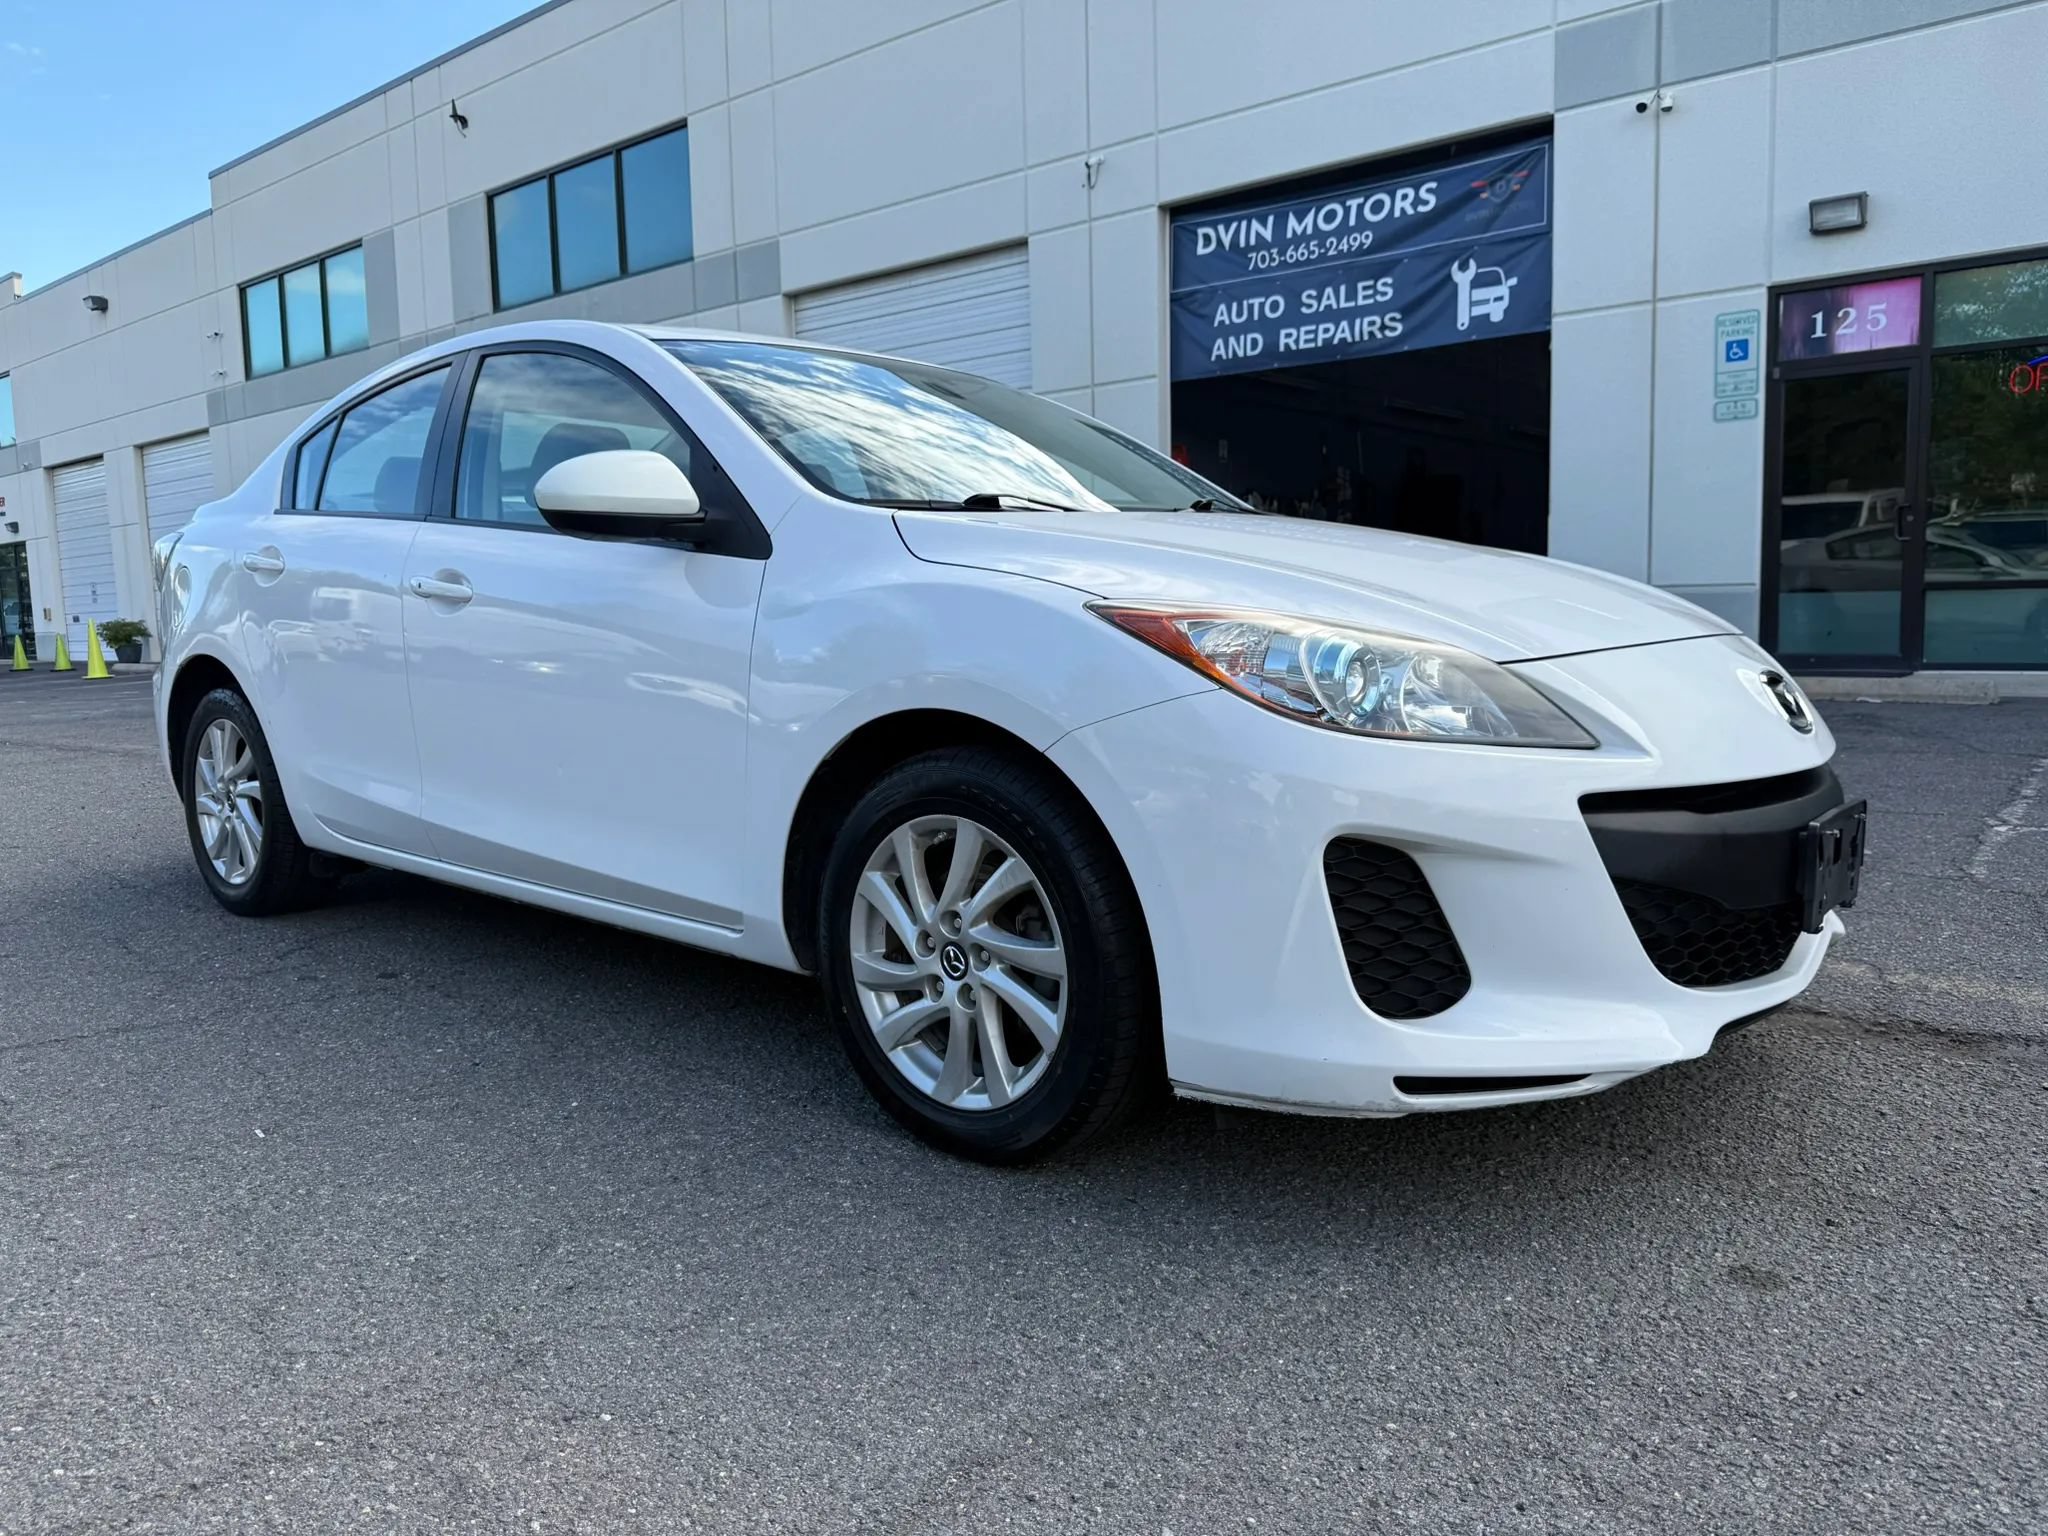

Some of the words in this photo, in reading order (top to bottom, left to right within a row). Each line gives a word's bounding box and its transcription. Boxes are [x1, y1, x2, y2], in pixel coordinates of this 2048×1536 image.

[1196, 215, 1274, 256] DVIN
[1286, 182, 1438, 239] MOTORS
[1247, 231, 1374, 271] 703-665-2499
[1213, 294, 1286, 328] AUTO
[1300, 277, 1394, 314] SALES
[1811, 302, 1888, 338] 125
[1210, 332, 1264, 362] AND
[1279, 312, 1404, 352] REPAIRS
